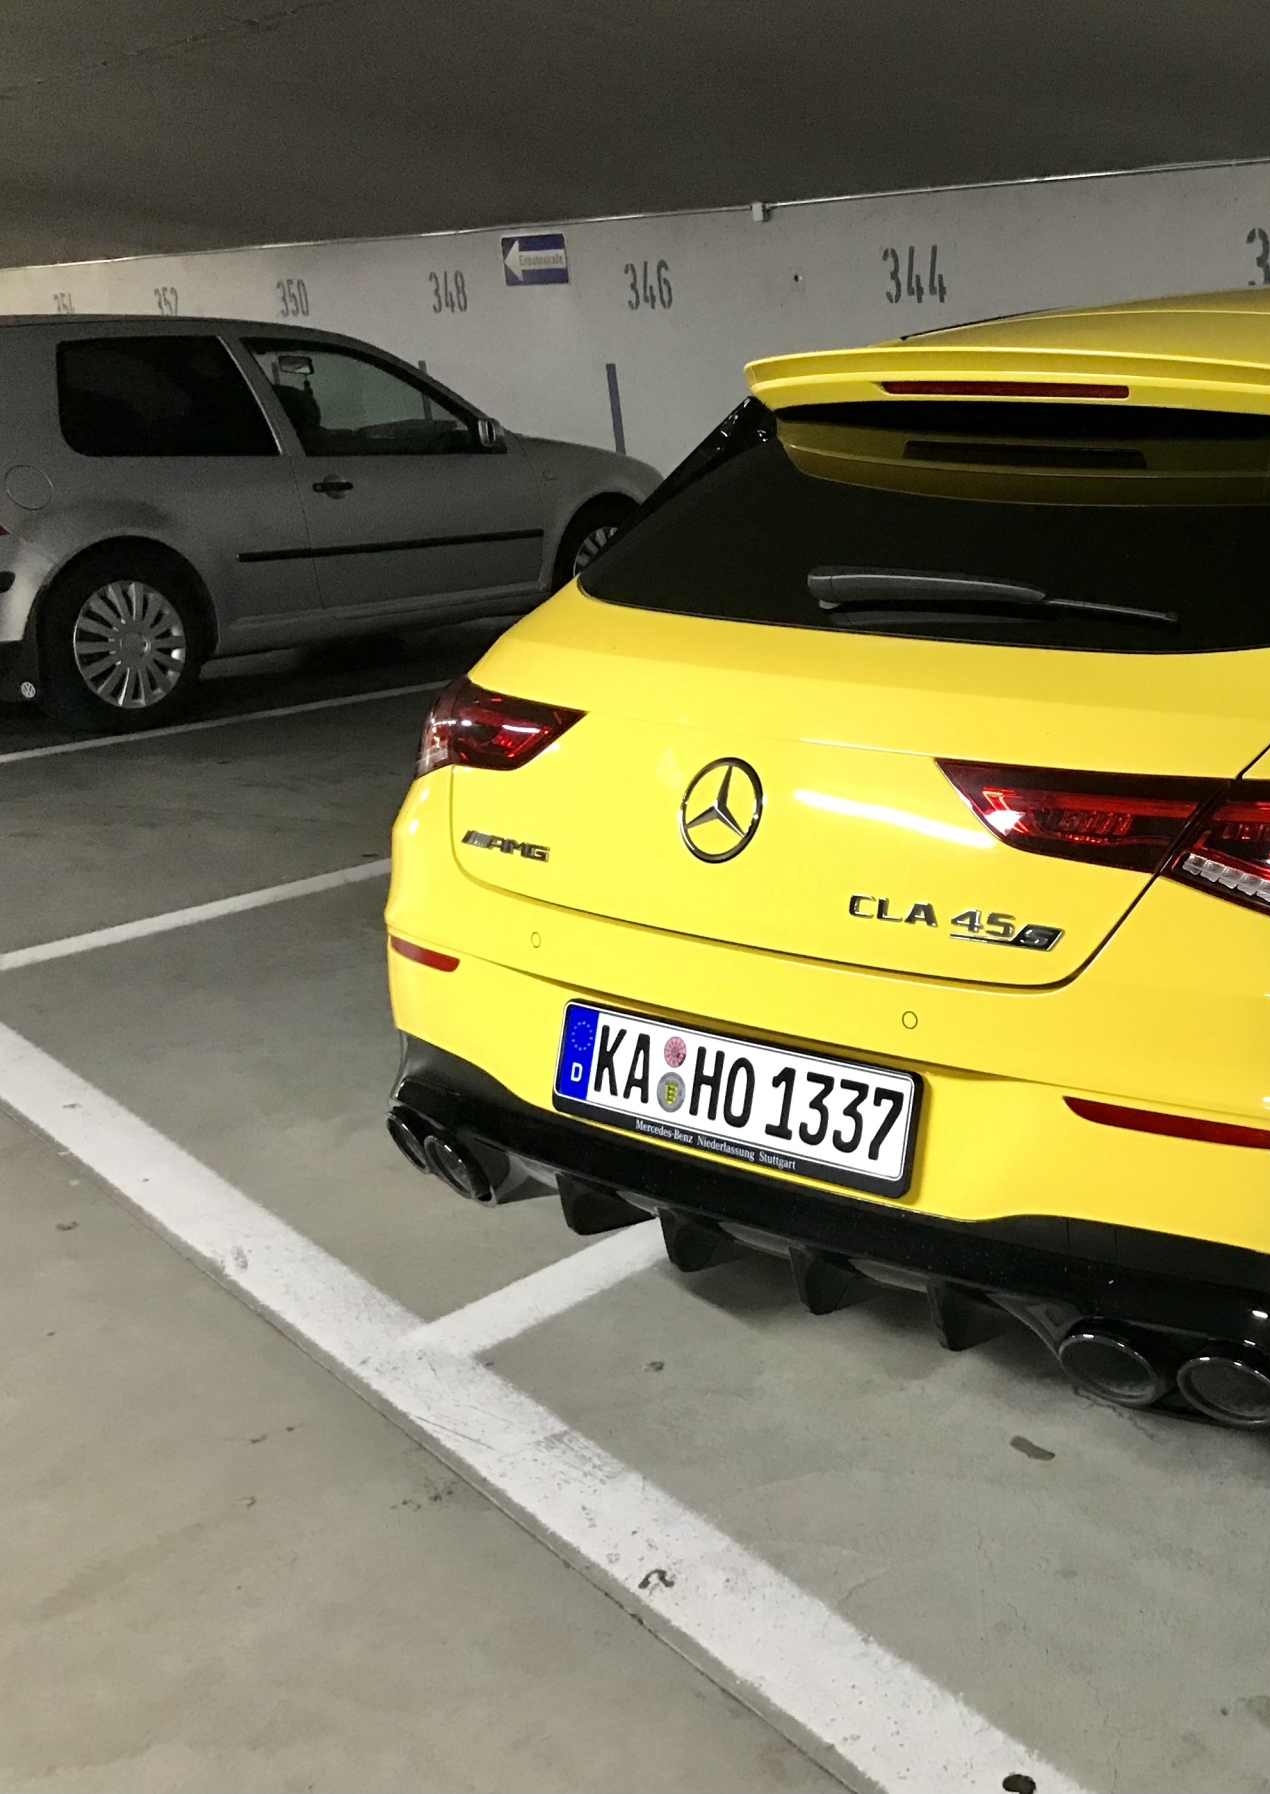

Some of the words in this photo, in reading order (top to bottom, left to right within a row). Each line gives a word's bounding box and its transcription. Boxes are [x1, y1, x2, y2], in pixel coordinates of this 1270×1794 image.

[429, 271, 468, 313] 348
[624, 260, 673, 310] 346
[882, 245, 947, 304] 344
[277, 279, 309, 318] 350
[484, 834, 551, 862] AMG
[849, 894, 937, 927] CLA
[571, 1062, 583, 1082] D
[594, 1024, 651, 1104] KA
[689, 1046, 756, 1128] HO
[765, 1067, 904, 1160] 1337
[635, 1118, 693, 1144] Mercedes-Benz
[697, 1135, 755, 1162] Niederlassung
[759, 1150, 796, 1171] Stuttgart
